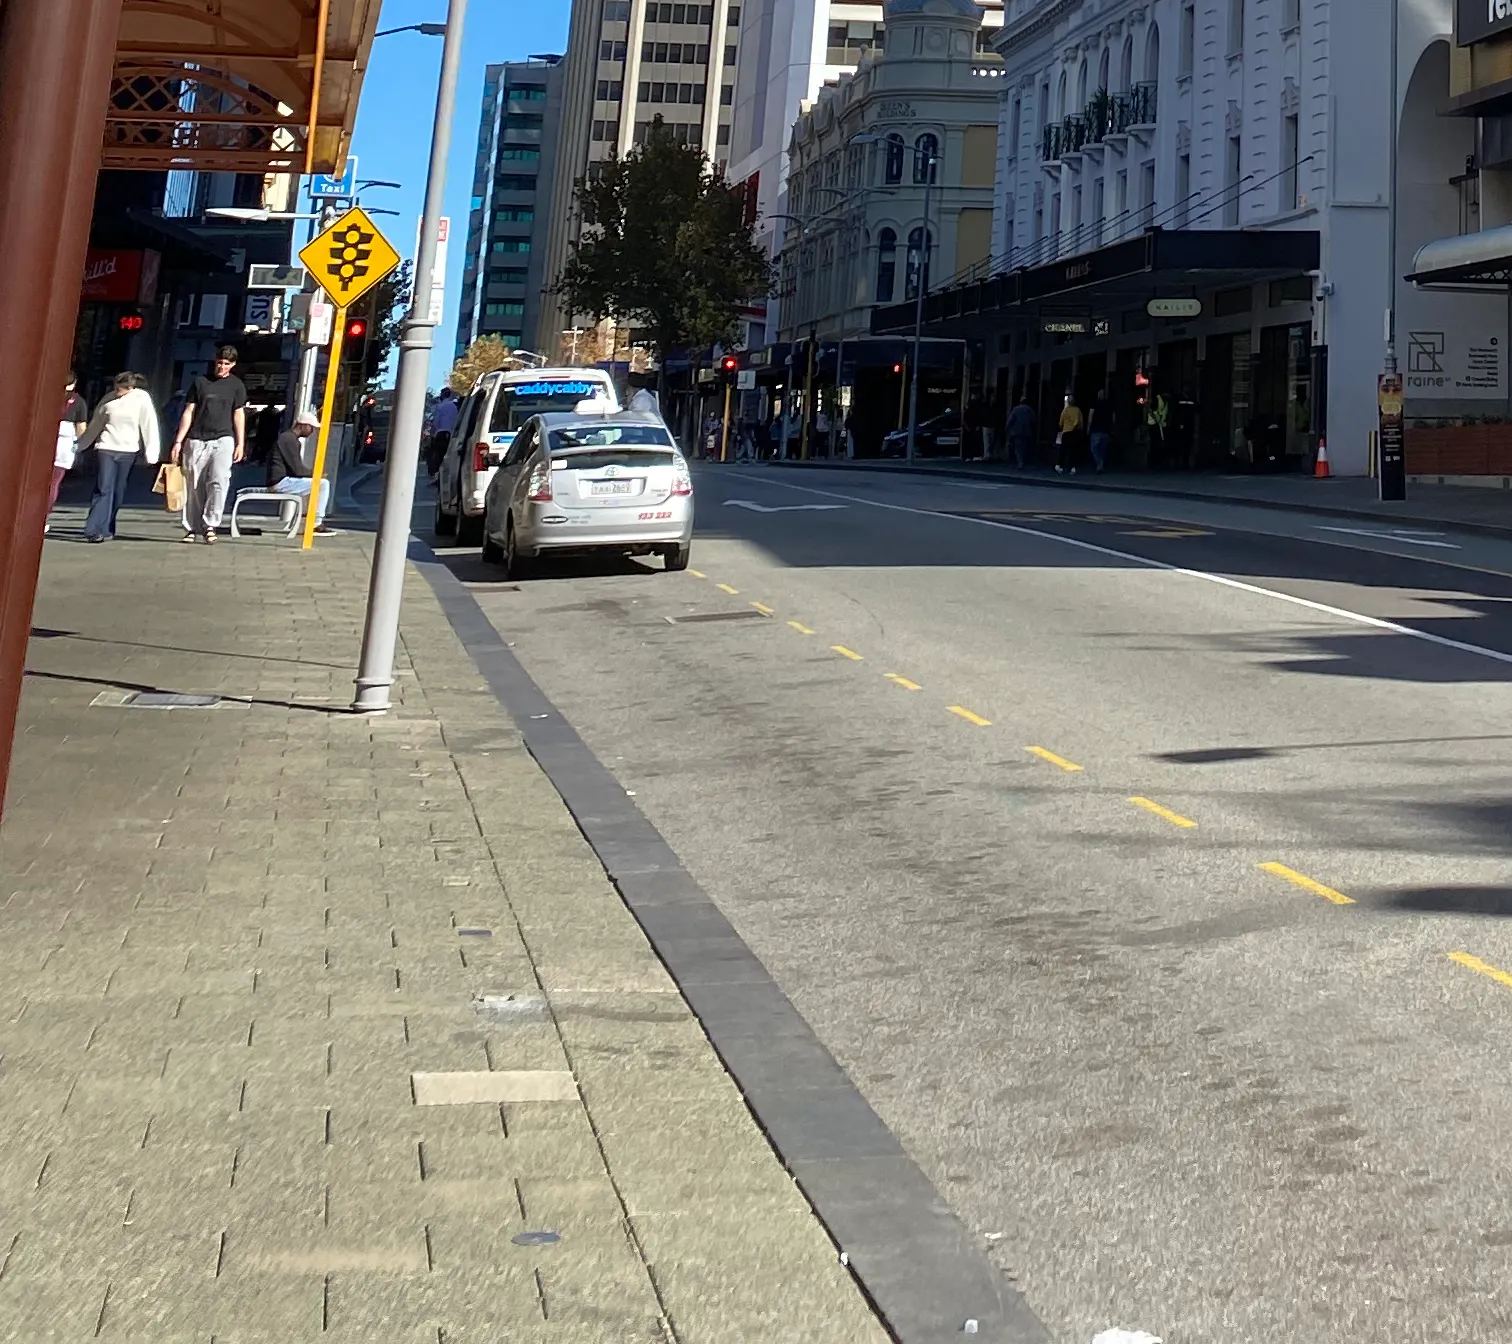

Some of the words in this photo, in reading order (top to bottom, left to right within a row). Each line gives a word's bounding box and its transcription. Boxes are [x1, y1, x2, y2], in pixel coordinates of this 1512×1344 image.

[320, 183, 345, 193] Taxi
[1407, 376, 1445, 388] raine
[515, 381, 594, 396] caddycabby
